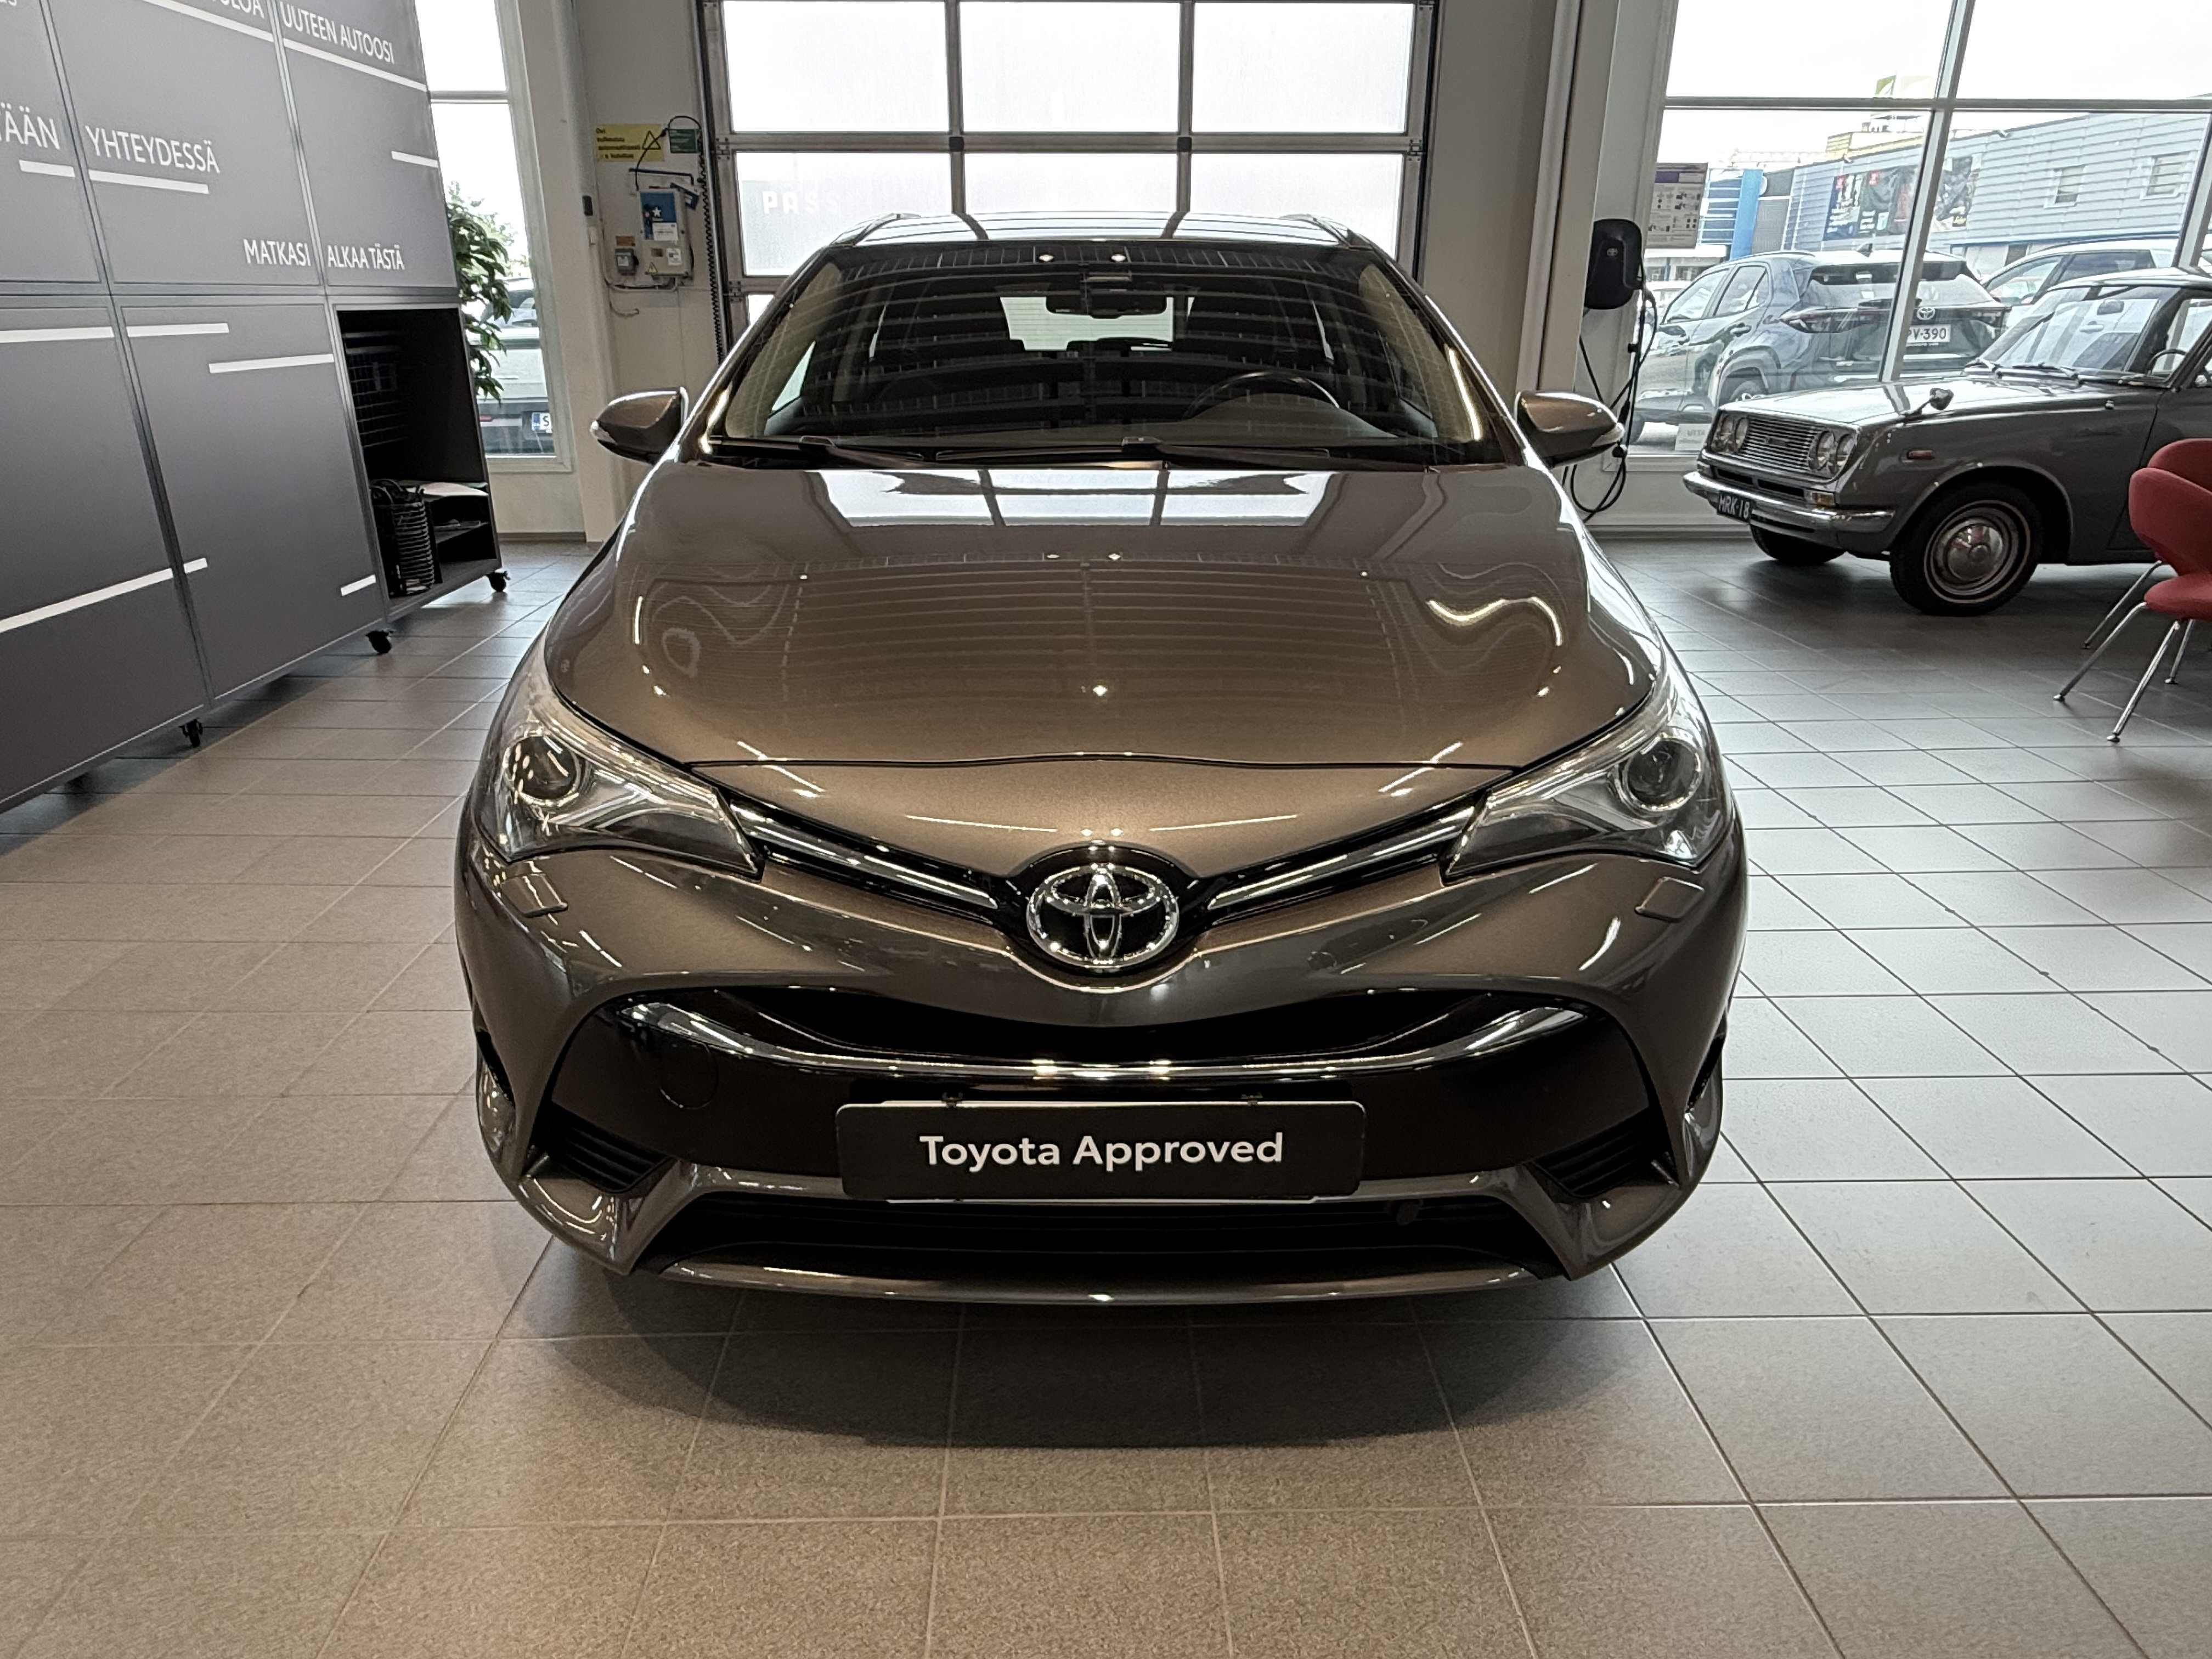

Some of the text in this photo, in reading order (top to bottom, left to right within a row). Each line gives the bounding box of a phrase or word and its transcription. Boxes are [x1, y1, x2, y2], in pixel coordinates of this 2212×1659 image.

[280, 1, 338, 44] UUTEEN
[340, 24, 395, 65] AUTOOSI
[0, 102, 220, 173] ÄÄN YHTEYDESSÄ
[243, 238, 405, 270] MATKASI ALKAA TÄSTÄ
[919, 1132, 1283, 1173] Toyota Approved
